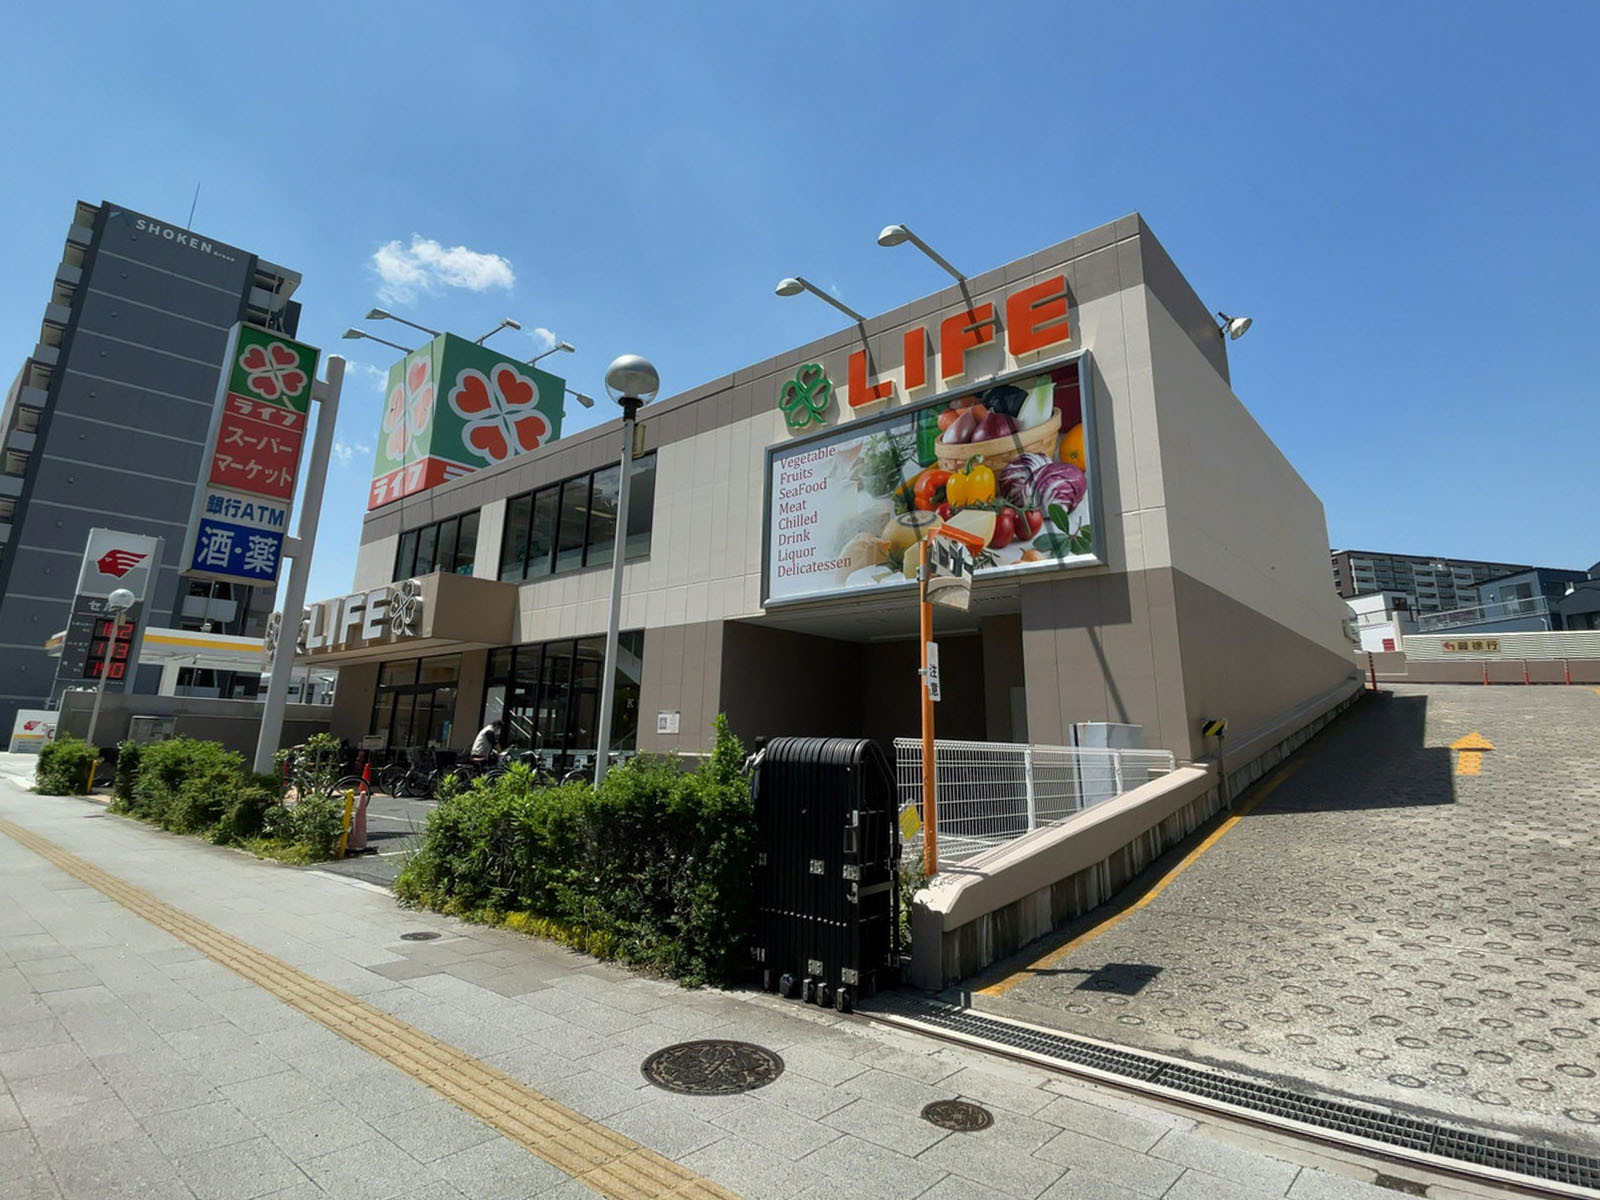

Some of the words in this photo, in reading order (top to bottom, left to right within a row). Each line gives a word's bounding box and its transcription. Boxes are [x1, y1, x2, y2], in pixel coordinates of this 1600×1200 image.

[136, 219, 212, 254] SHOKEN
[848, 274, 1072, 409] LIFE
[233, 398, 297, 426] ライフ
[224, 426, 293, 454] スーパー
[215, 453, 292, 487] マーケット
[780, 446, 836, 470] Vegetable
[374, 460, 423, 504] ライフ
[779, 477, 828, 500] SeaFood
[780, 468, 813, 485] Fruits
[206, 494, 285, 527] 銀行ATM
[778, 511, 818, 531] Chilled
[779, 500, 807, 515] Meat
[197, 526, 279, 574] 酒・薬
[778, 529, 811, 547] Drink
[777, 556, 852, 578] Delicatessen
[778, 546, 817, 565] Liquor
[306, 587, 391, 649] LIFE
